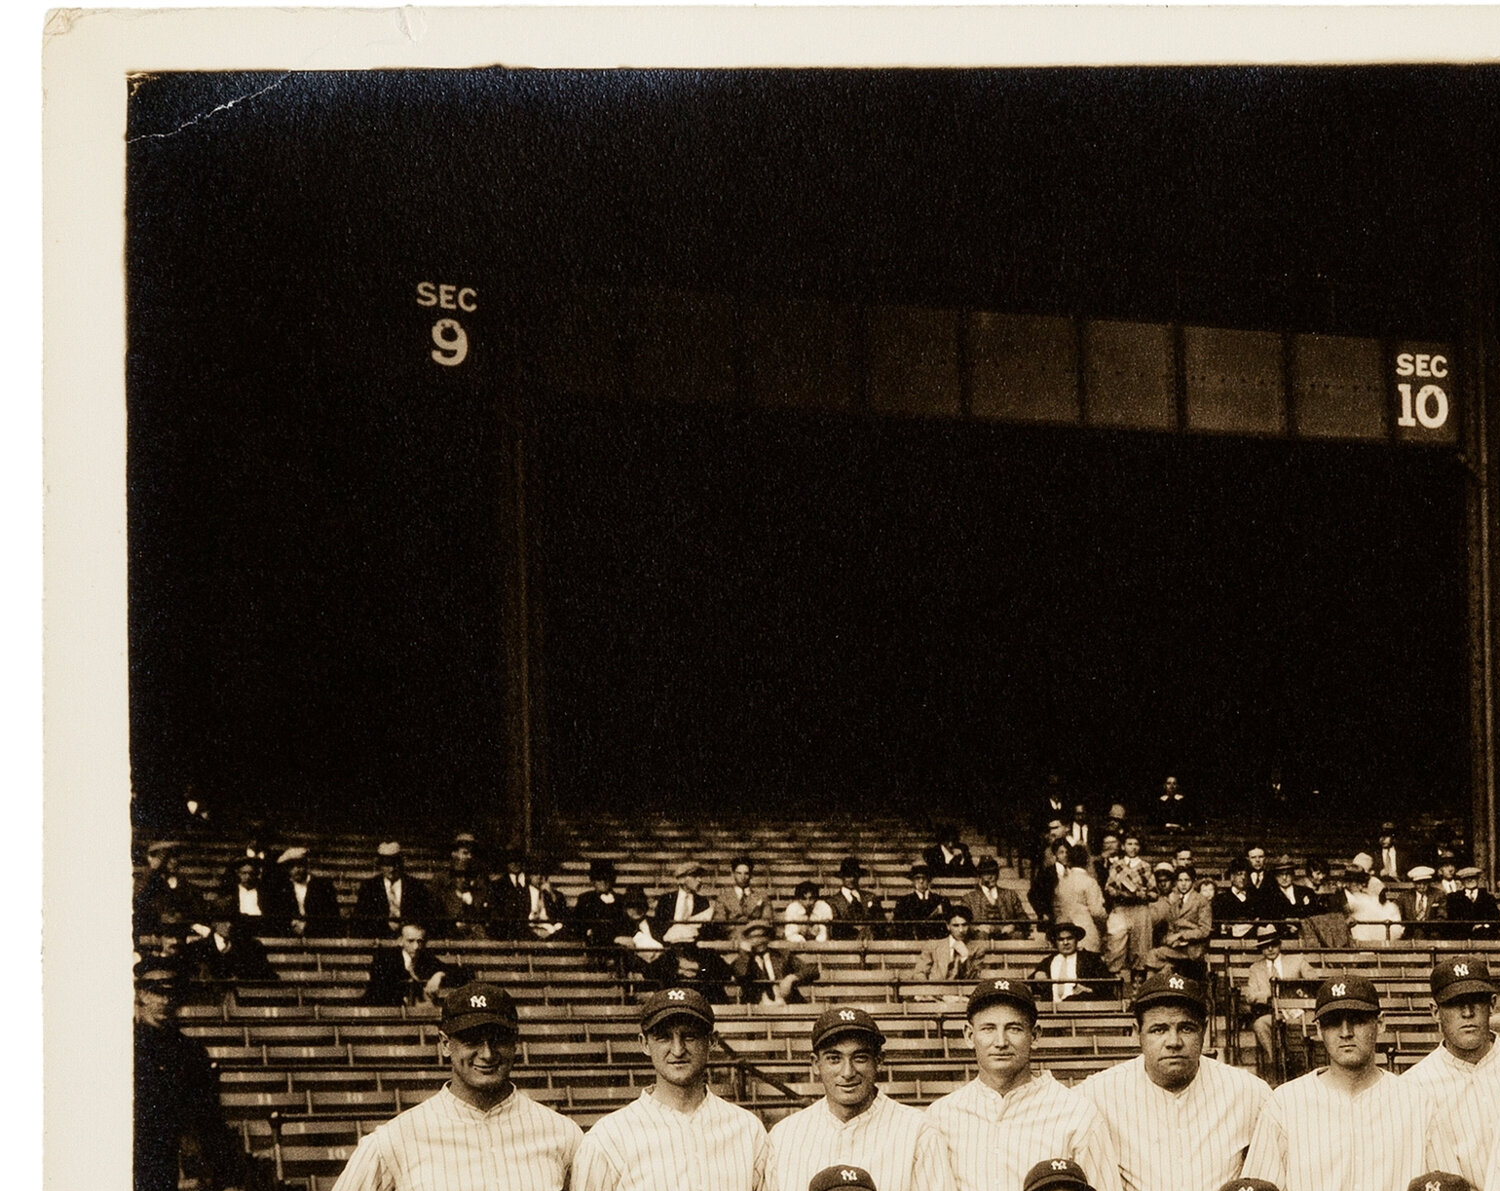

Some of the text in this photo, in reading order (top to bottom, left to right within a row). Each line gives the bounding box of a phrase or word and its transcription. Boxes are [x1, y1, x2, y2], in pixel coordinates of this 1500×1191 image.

[416, 281, 478, 313] SEC
[431, 318, 469, 367] 9
[1395, 352, 1449, 378] SEC
[1397, 383, 1449, 430] 10
